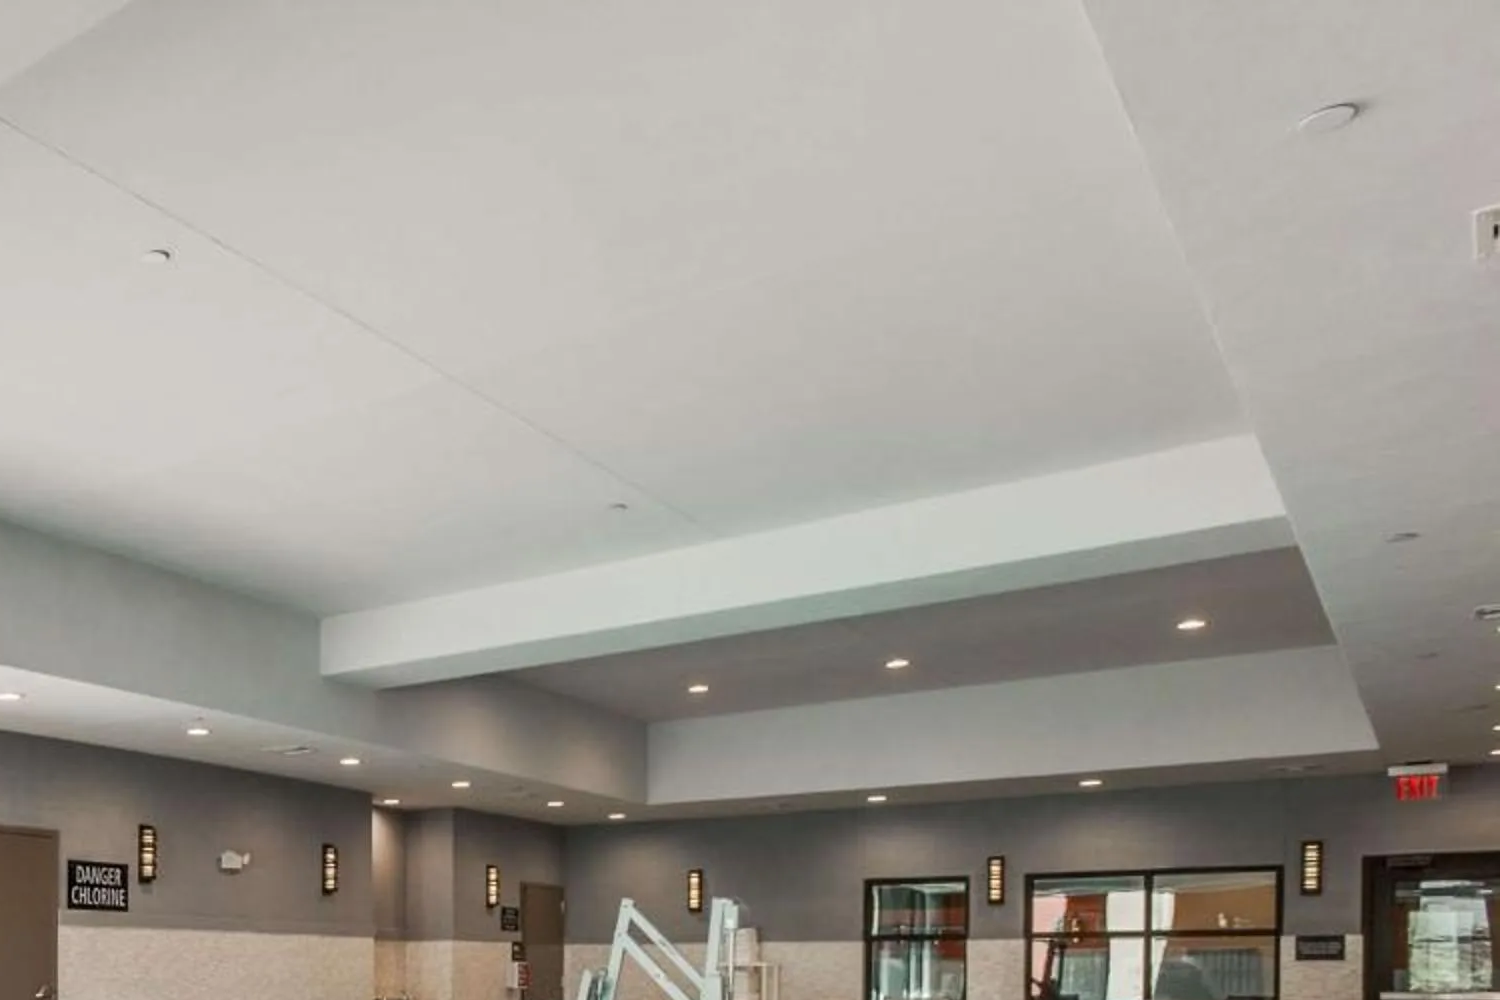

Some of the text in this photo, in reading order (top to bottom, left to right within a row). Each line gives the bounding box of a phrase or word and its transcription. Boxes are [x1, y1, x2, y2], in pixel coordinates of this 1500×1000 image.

[1396, 775, 1440, 801] EXIT
[75, 865, 122, 886] DANGER
[71, 886, 126, 907] CHLORINE
